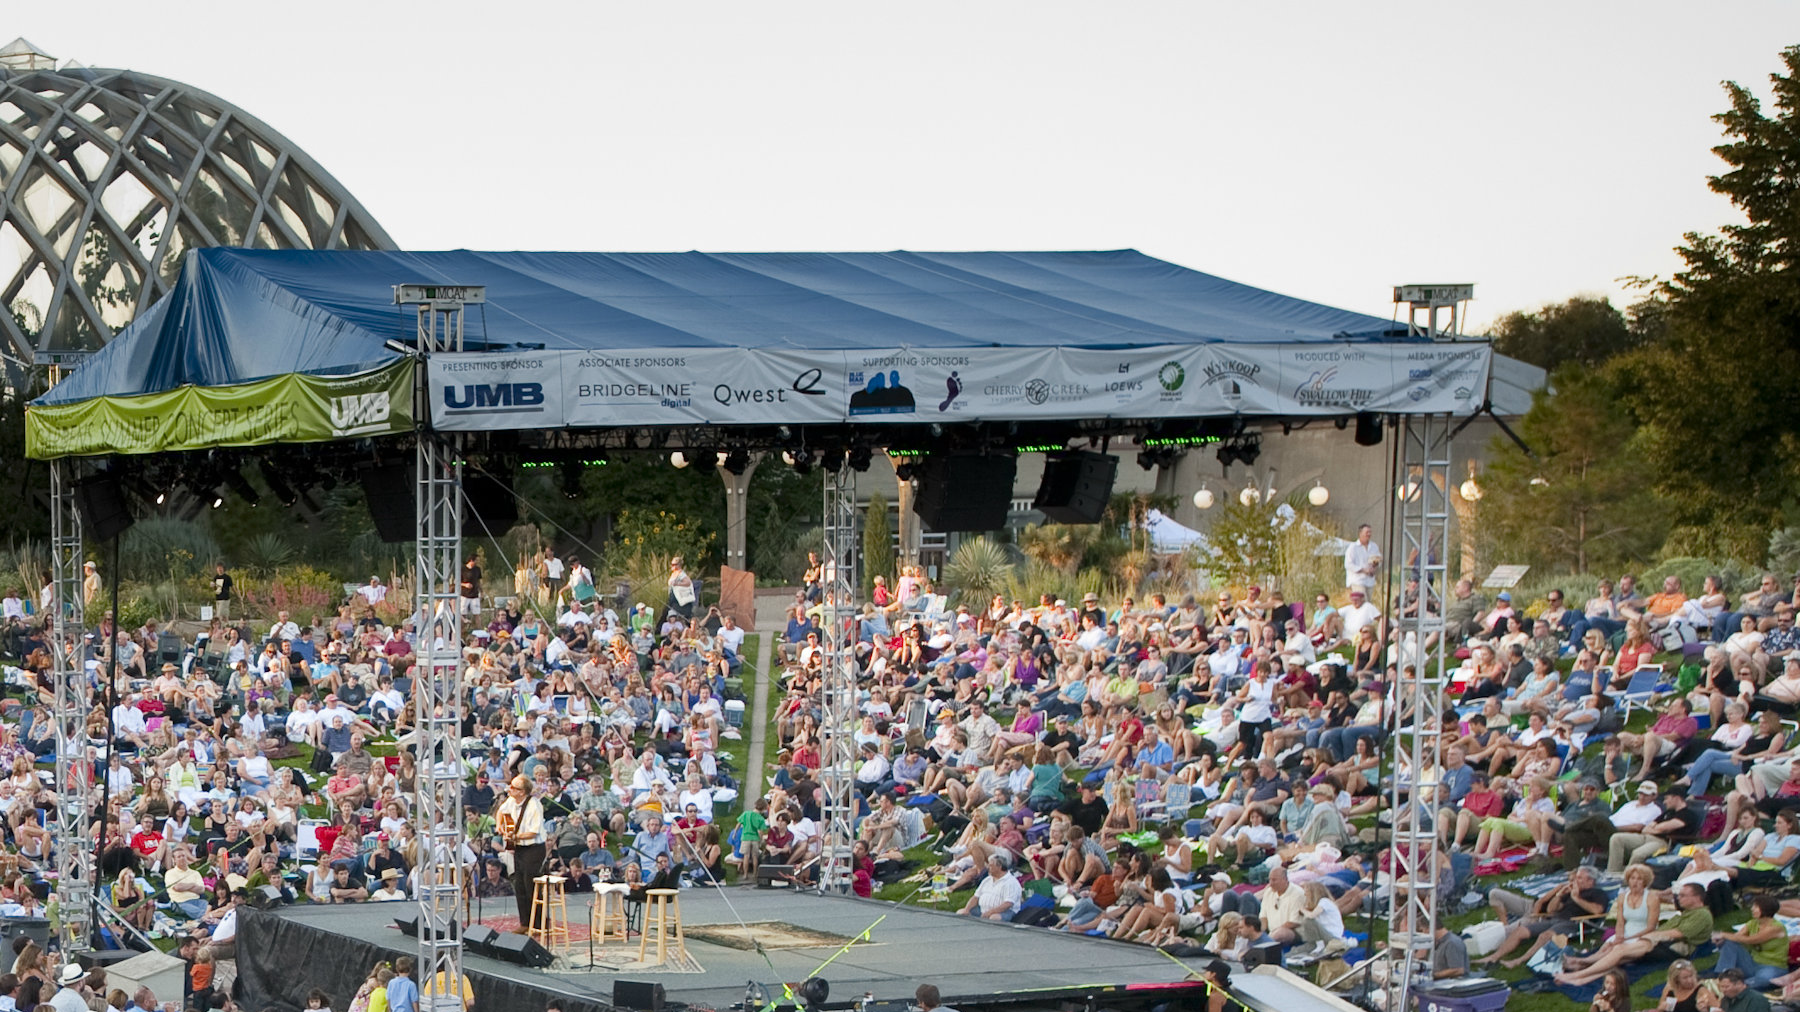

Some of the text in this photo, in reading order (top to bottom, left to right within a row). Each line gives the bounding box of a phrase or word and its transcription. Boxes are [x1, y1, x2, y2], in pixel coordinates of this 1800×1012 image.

[1295, 352, 1366, 361] PRODUCED WITH
[1408, 352, 1434, 360] MEDIA
[443, 360, 544, 372] PRESENTING SPONSOR
[578, 358, 686, 368] ASSOCIATE SPONSORS
[863, 357, 969, 367] SUPPORTING SPONSORS
[1203, 360, 1261, 378] WYNKOOP
[984, 384, 1089, 395] CHERRY CREEK
[1105, 381, 1143, 392] LOEWS
[444, 383, 544, 409] UMB
[714, 384, 785, 407] Qwest
[660, 399, 691, 408] digital
[330, 391, 390, 429] UMB
[244, 400, 300, 441] SERIES
